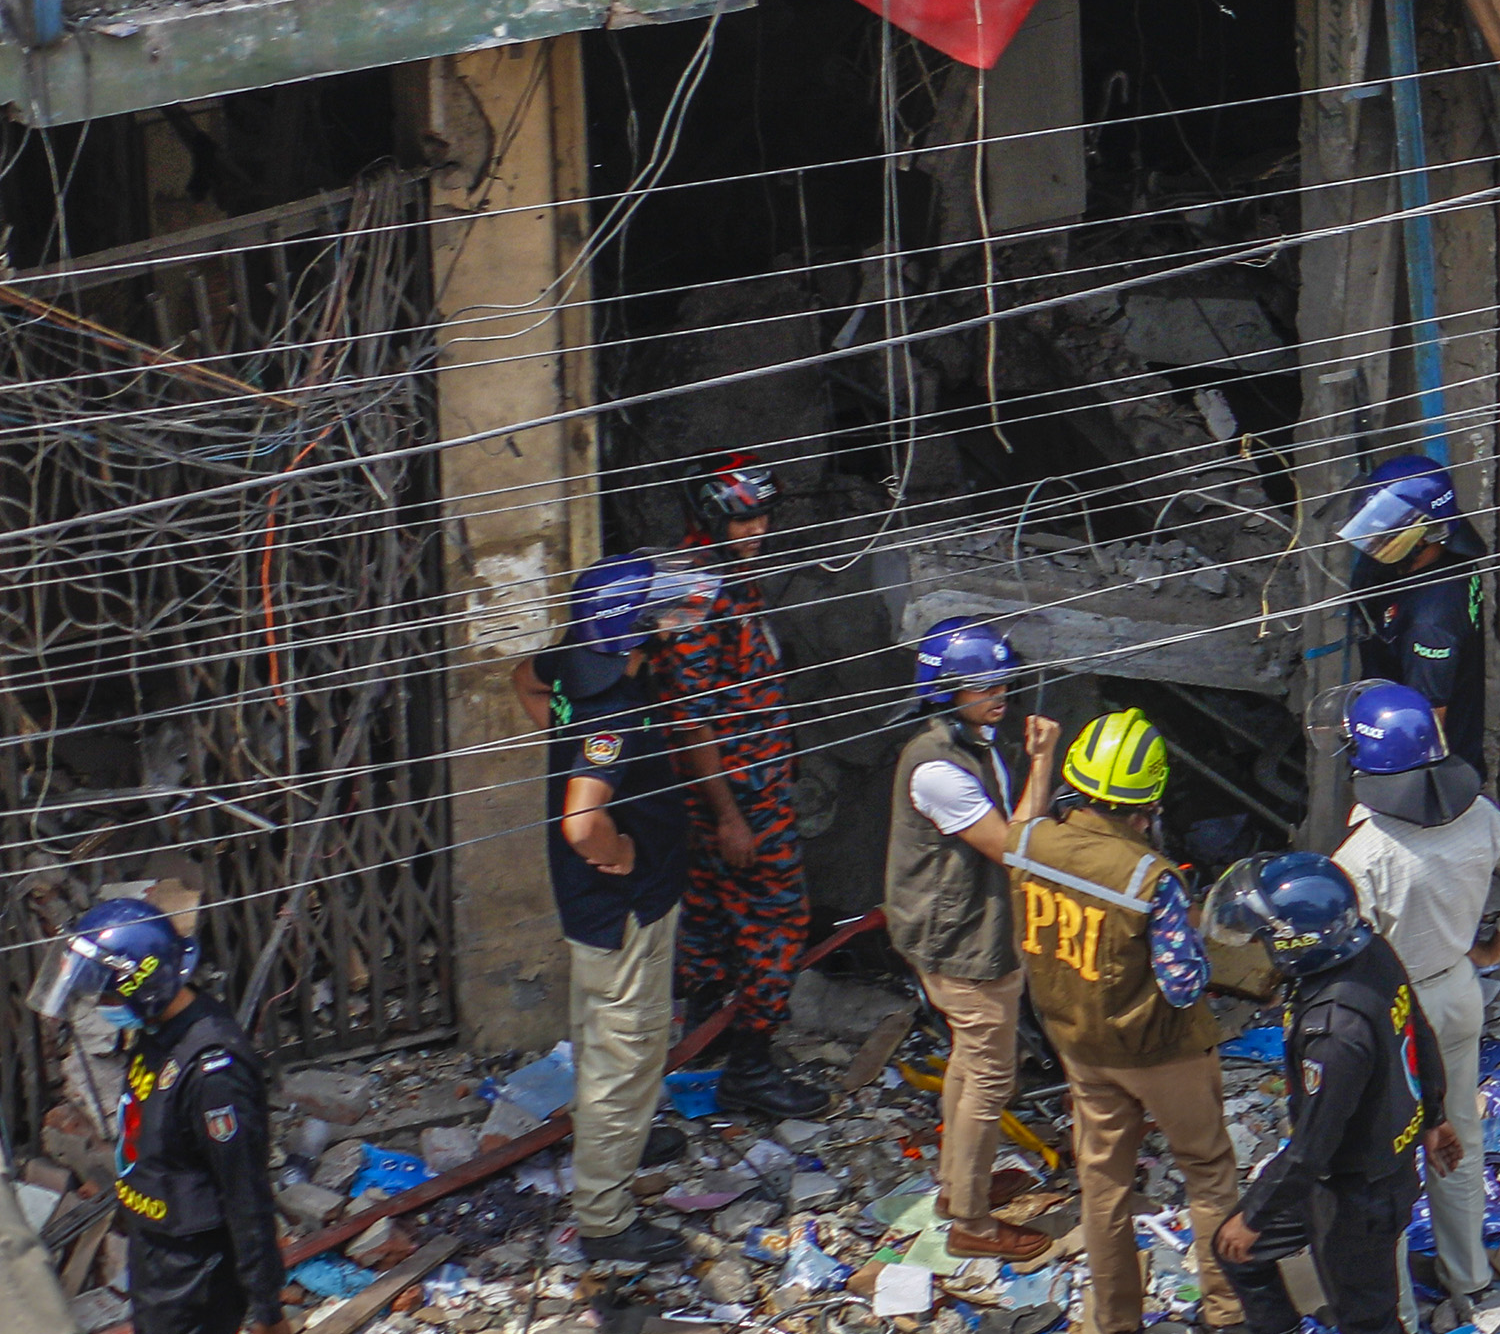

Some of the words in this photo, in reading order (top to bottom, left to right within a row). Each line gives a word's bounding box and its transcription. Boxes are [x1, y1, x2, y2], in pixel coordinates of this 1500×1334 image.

[1430, 489, 1454, 510] POLICE
[917, 652, 944, 667] POLICE
[1413, 641, 1451, 660] POLICE
[1355, 721, 1386, 740] POLICE
[1021, 881, 1107, 982] PBI
[1273, 935, 1319, 952] RAB
[117, 954, 160, 997] RAB
